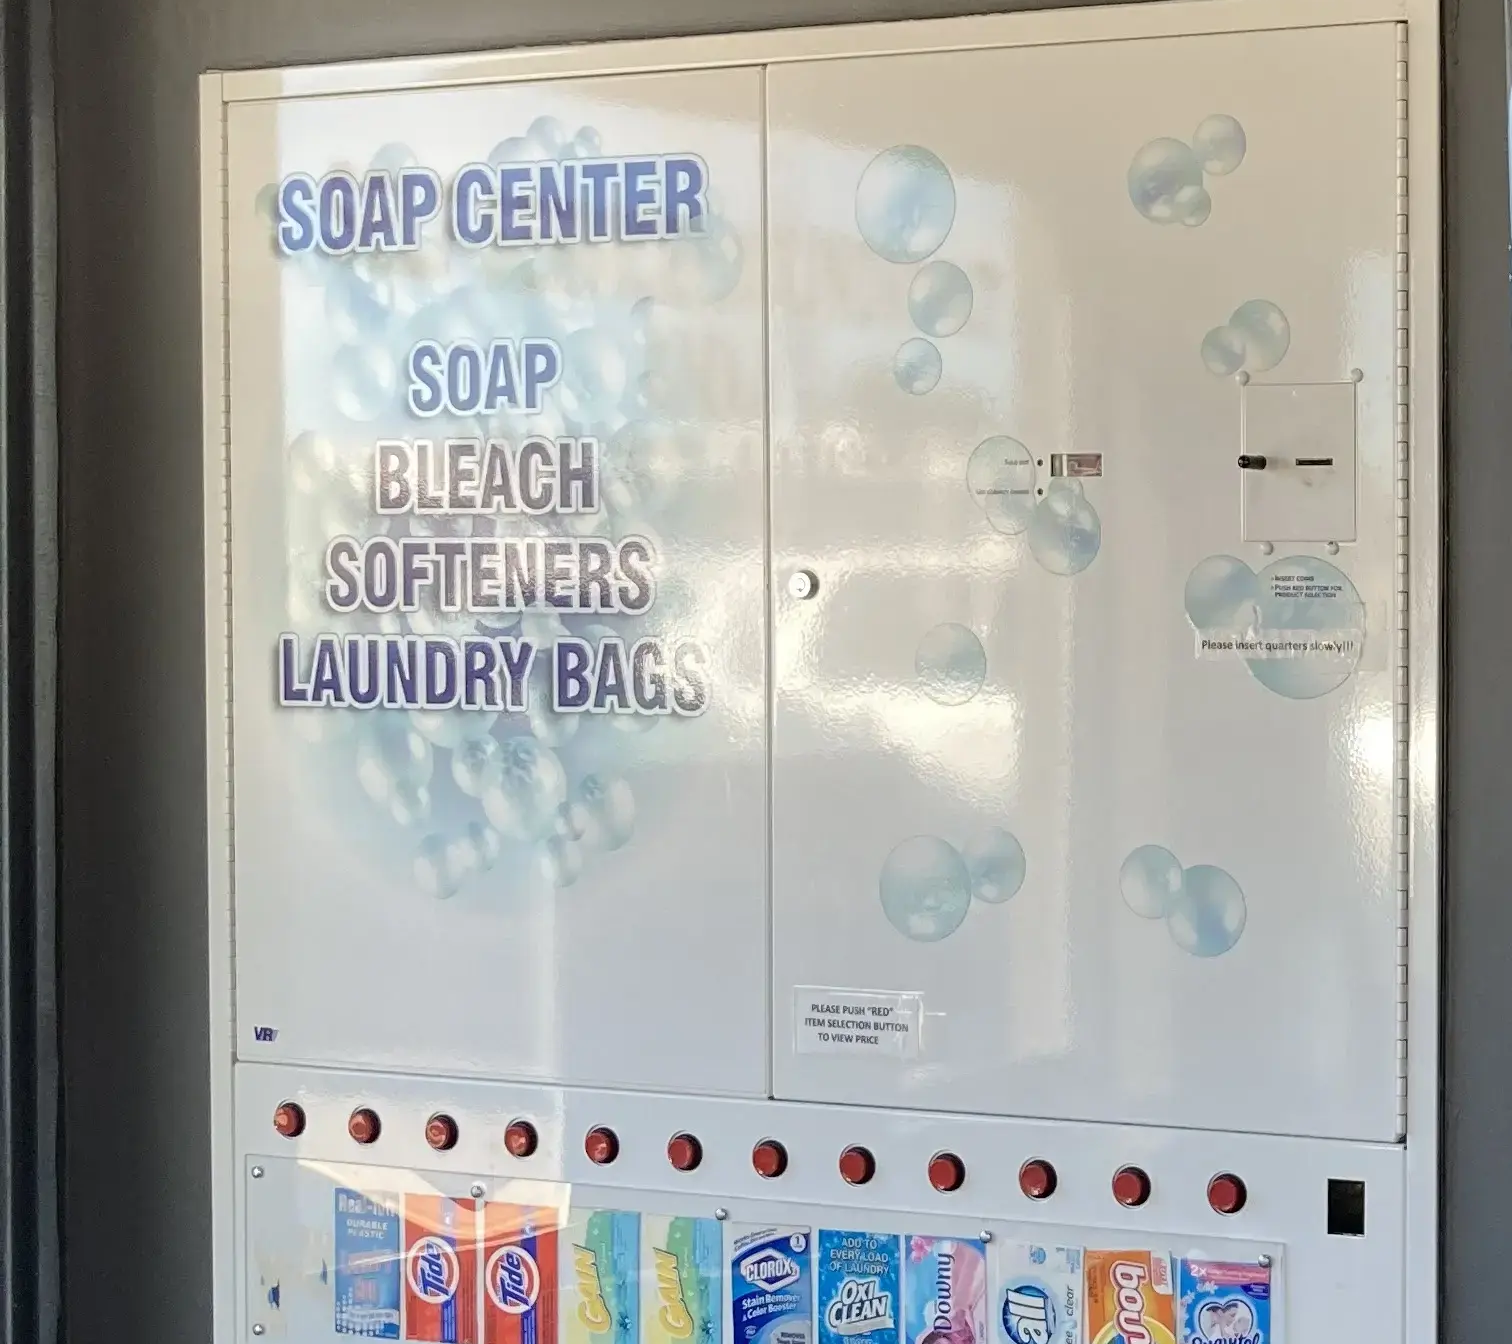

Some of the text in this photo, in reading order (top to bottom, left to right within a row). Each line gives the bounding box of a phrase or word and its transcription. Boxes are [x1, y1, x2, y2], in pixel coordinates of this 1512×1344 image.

[278, 155, 704, 253] SOAP CENTER
[409, 341, 557, 415] SOAP
[377, 439, 599, 513] BLEACH
[326, 538, 656, 615] SOFTENERS
[1201, 639, 1233, 650] Please
[1235, 640, 1263, 650] insert
[1265, 640, 1308, 652] quarters
[280, 636, 708, 716] LAUNDRY BAGS
[811, 1003, 841, 1015] PLEASE
[842, 1005, 866, 1016] PUSH
[804, 1017, 909, 1033] ITEM SELECTION BUTTON
[817, 1032, 879, 1045] TO VIEW PRICE
[346, 1218, 389, 1231] DURABLE
[829, 1248, 889, 1263] EVERY LOAD
[841, 1237, 878, 1250] ADD TO
[420, 1241, 451, 1297] Tide
[499, 1250, 531, 1308] Tide
[745, 1257, 792, 1282] CLOROX
[829, 1261, 890, 1275] OF LAUNDRY
[742, 1293, 801, 1310] Stain Remover
[841, 1279, 876, 1305] OXI
[933, 1252, 956, 1332] Downy
[1064, 1285, 1075, 1317] clear
[747, 1308, 768, 1319] Color
[767, 1303, 797, 1314] Booster
[828, 1295, 889, 1329] CLEAN
